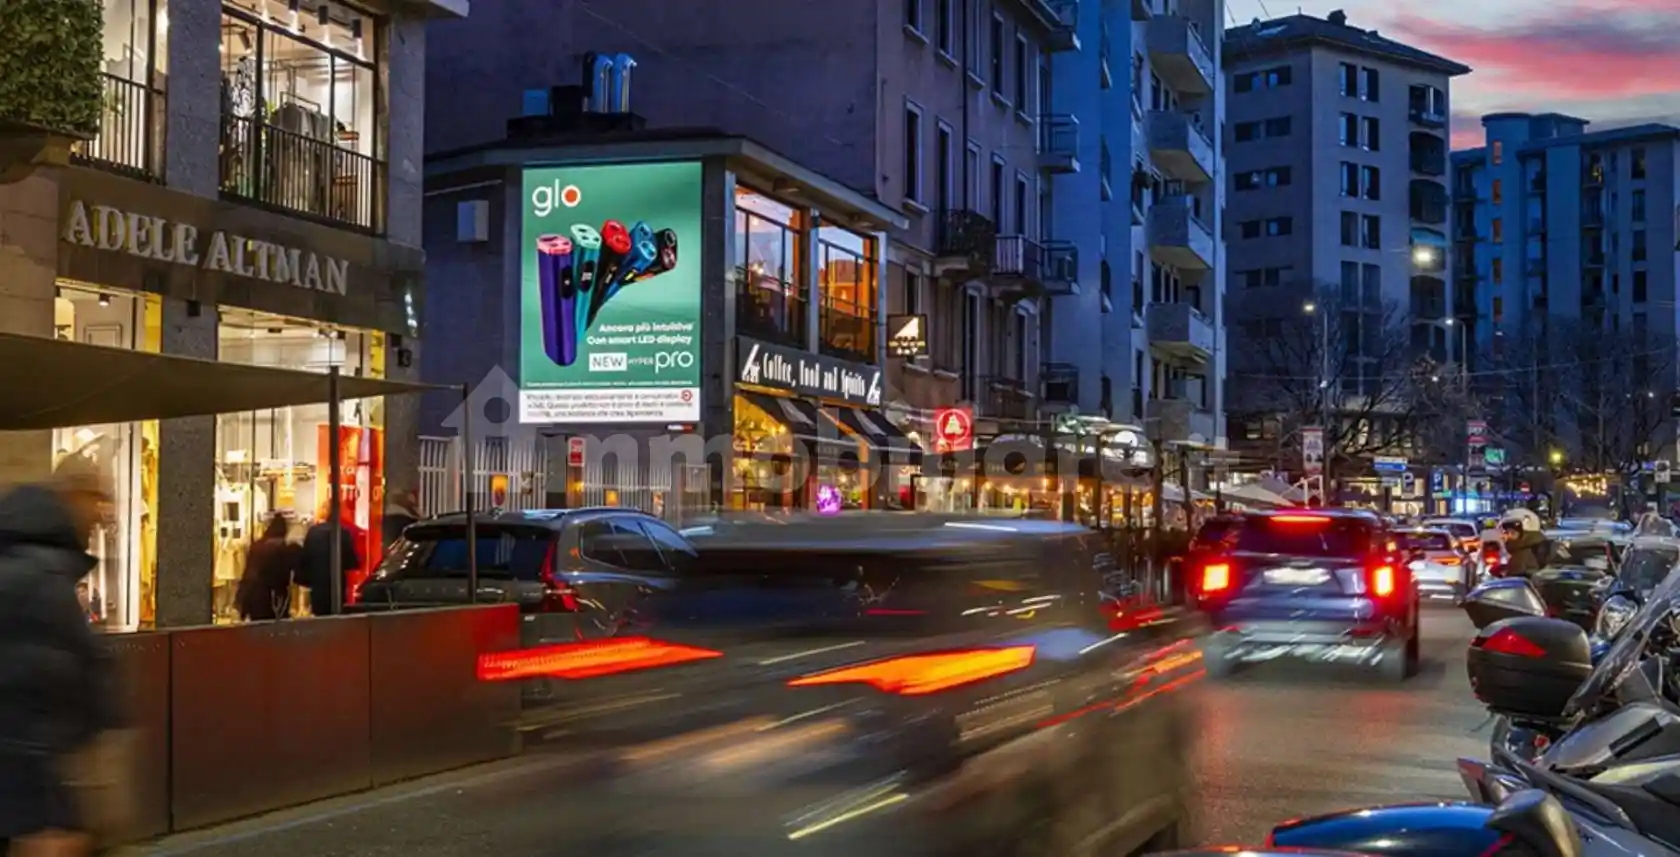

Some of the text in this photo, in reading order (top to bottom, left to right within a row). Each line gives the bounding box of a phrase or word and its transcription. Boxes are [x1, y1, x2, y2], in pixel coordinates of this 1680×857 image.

[532, 178, 581, 217] glo
[60, 199, 349, 297] ADELE ALTMAN
[599, 323, 634, 333] Ancora
[608, 335, 636, 345] smart
[638, 334, 656, 344] LED
[657, 333, 692, 345] display
[591, 355, 625, 369] NEW
[655, 350, 694, 374] pro
[823, 366, 838, 393] and
